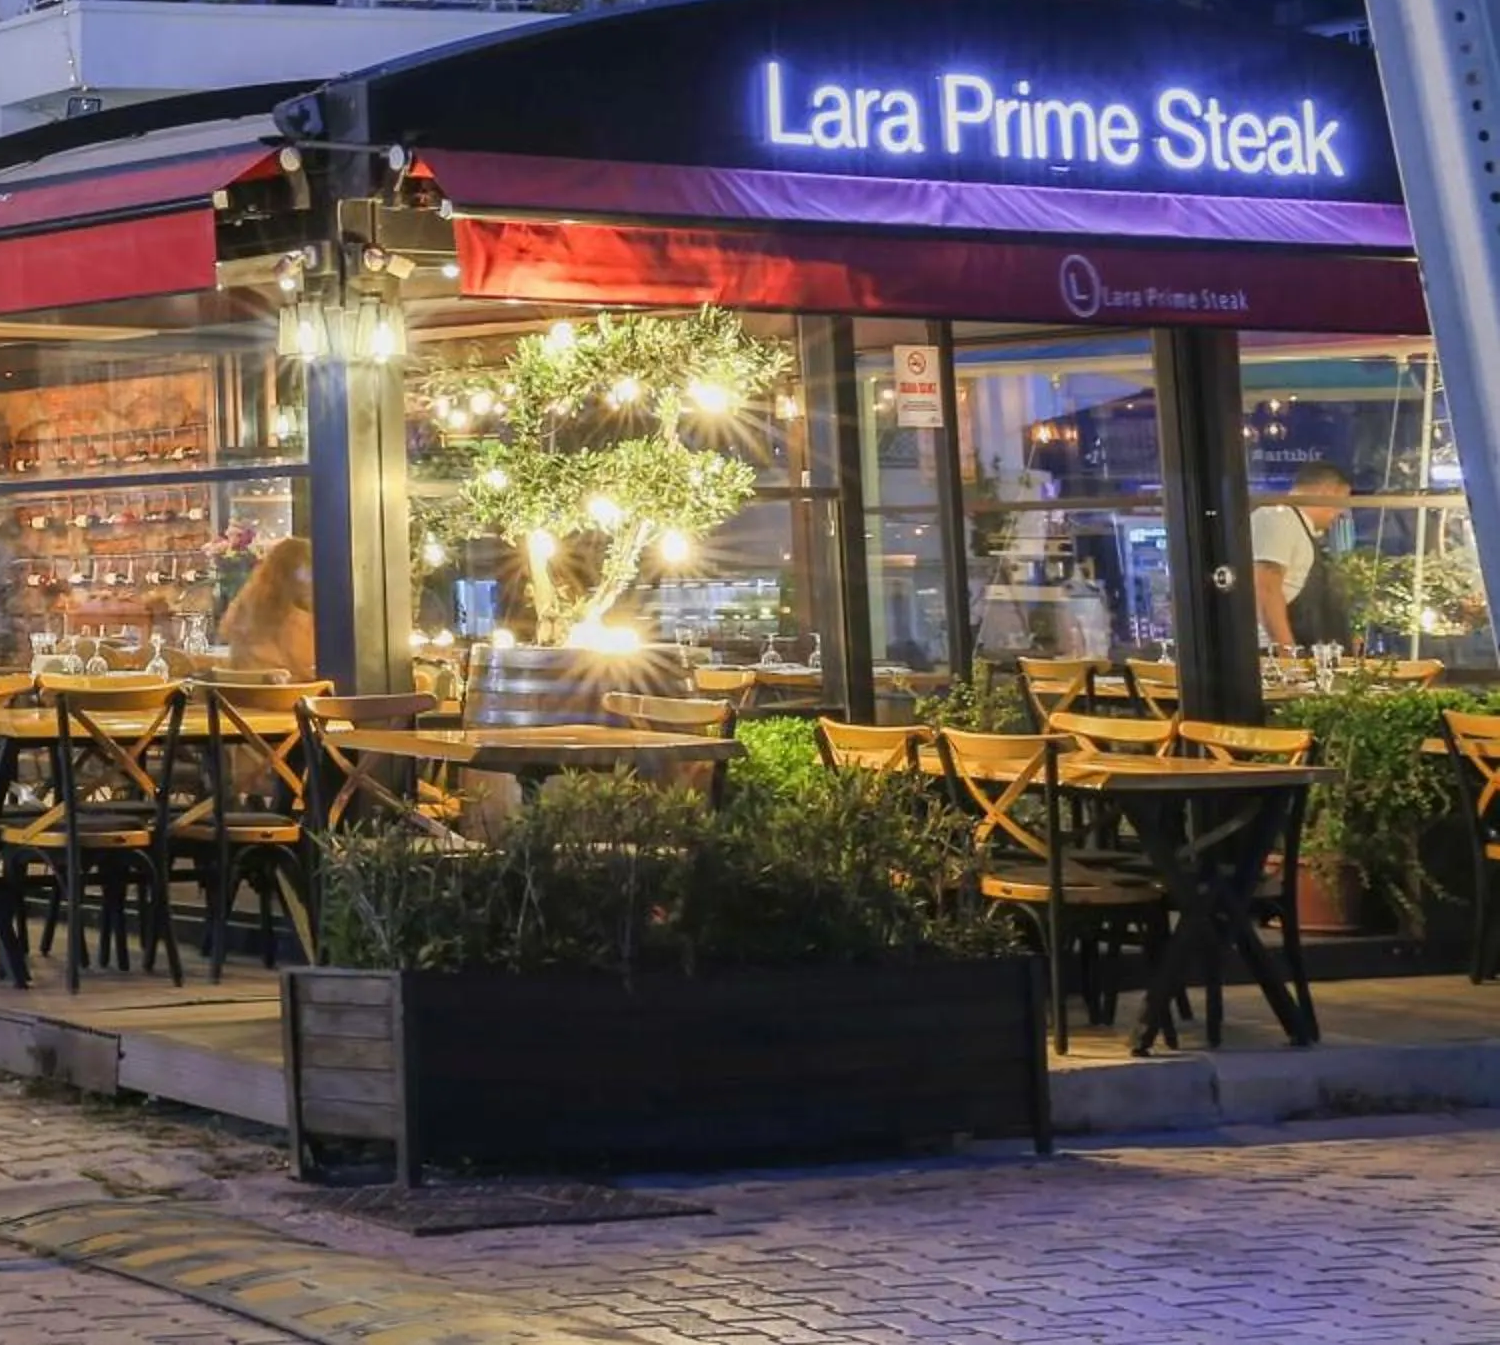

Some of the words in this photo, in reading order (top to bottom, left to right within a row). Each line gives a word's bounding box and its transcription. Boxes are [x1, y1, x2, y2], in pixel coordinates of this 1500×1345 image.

[766, 61, 925, 154] Lara
[943, 73, 1140, 166] Prime
[1157, 87, 1345, 177] Steak
[1201, 287, 1249, 310] Steak
